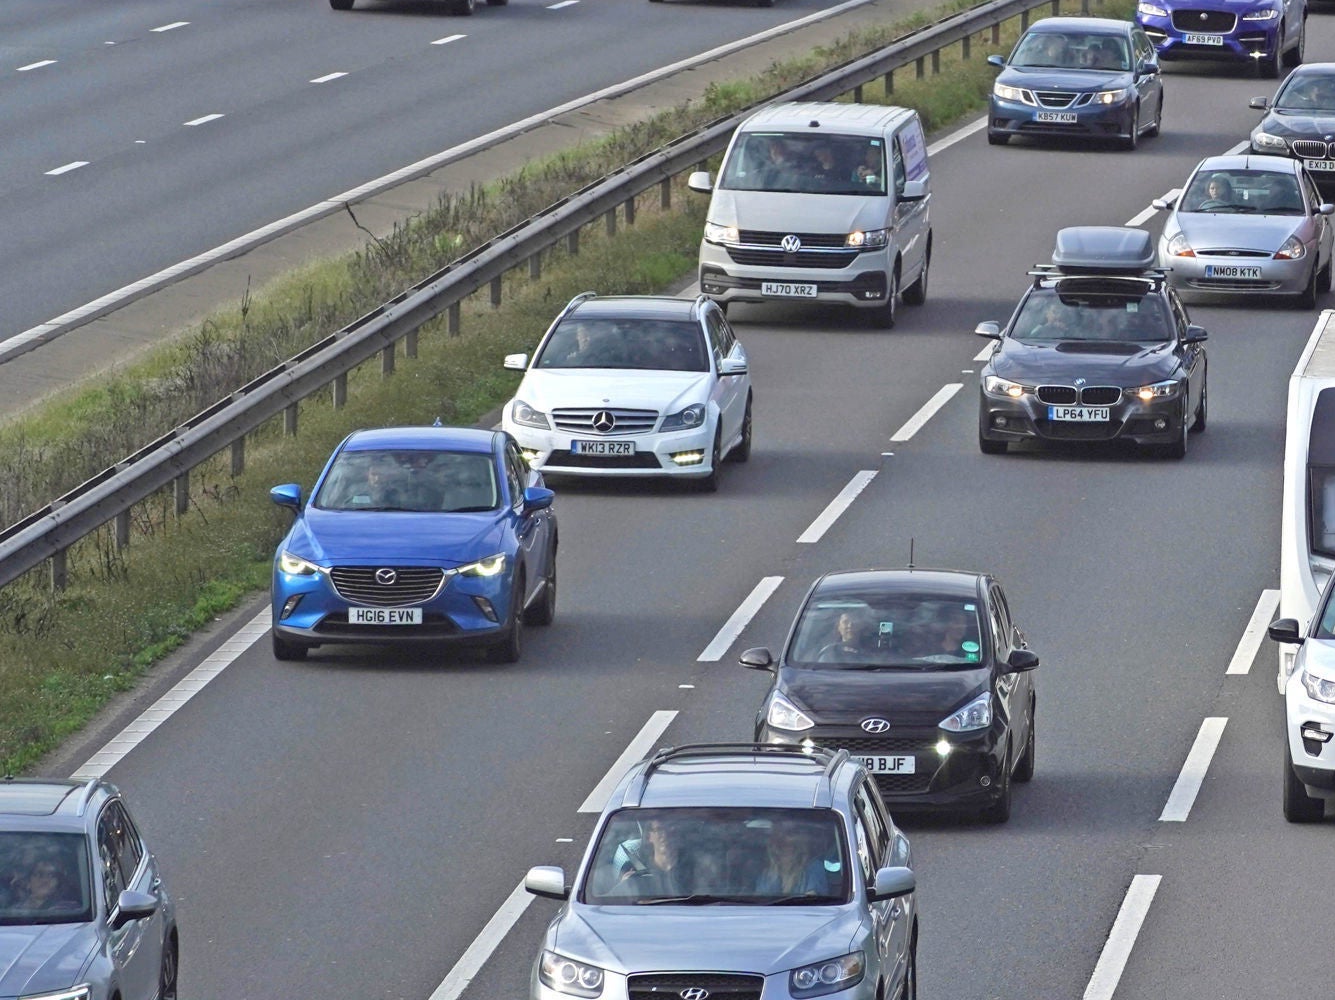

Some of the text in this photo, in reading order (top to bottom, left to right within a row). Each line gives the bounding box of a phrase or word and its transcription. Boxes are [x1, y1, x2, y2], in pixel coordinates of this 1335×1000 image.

[1187, 35, 1206, 43] AF69
[1038, 112, 1076, 122] KB57 KUW
[1308, 160, 1328, 169] EX13
[1213, 267, 1259, 277] NM08 KTK
[765, 284, 813, 296] HJ70 XRZ
[1055, 408, 1108, 419] LP64 YFU
[581, 443, 631, 454] WK13 RZR
[357, 610, 414, 622] HG16 EVN
[878, 757, 906, 771] BJF
